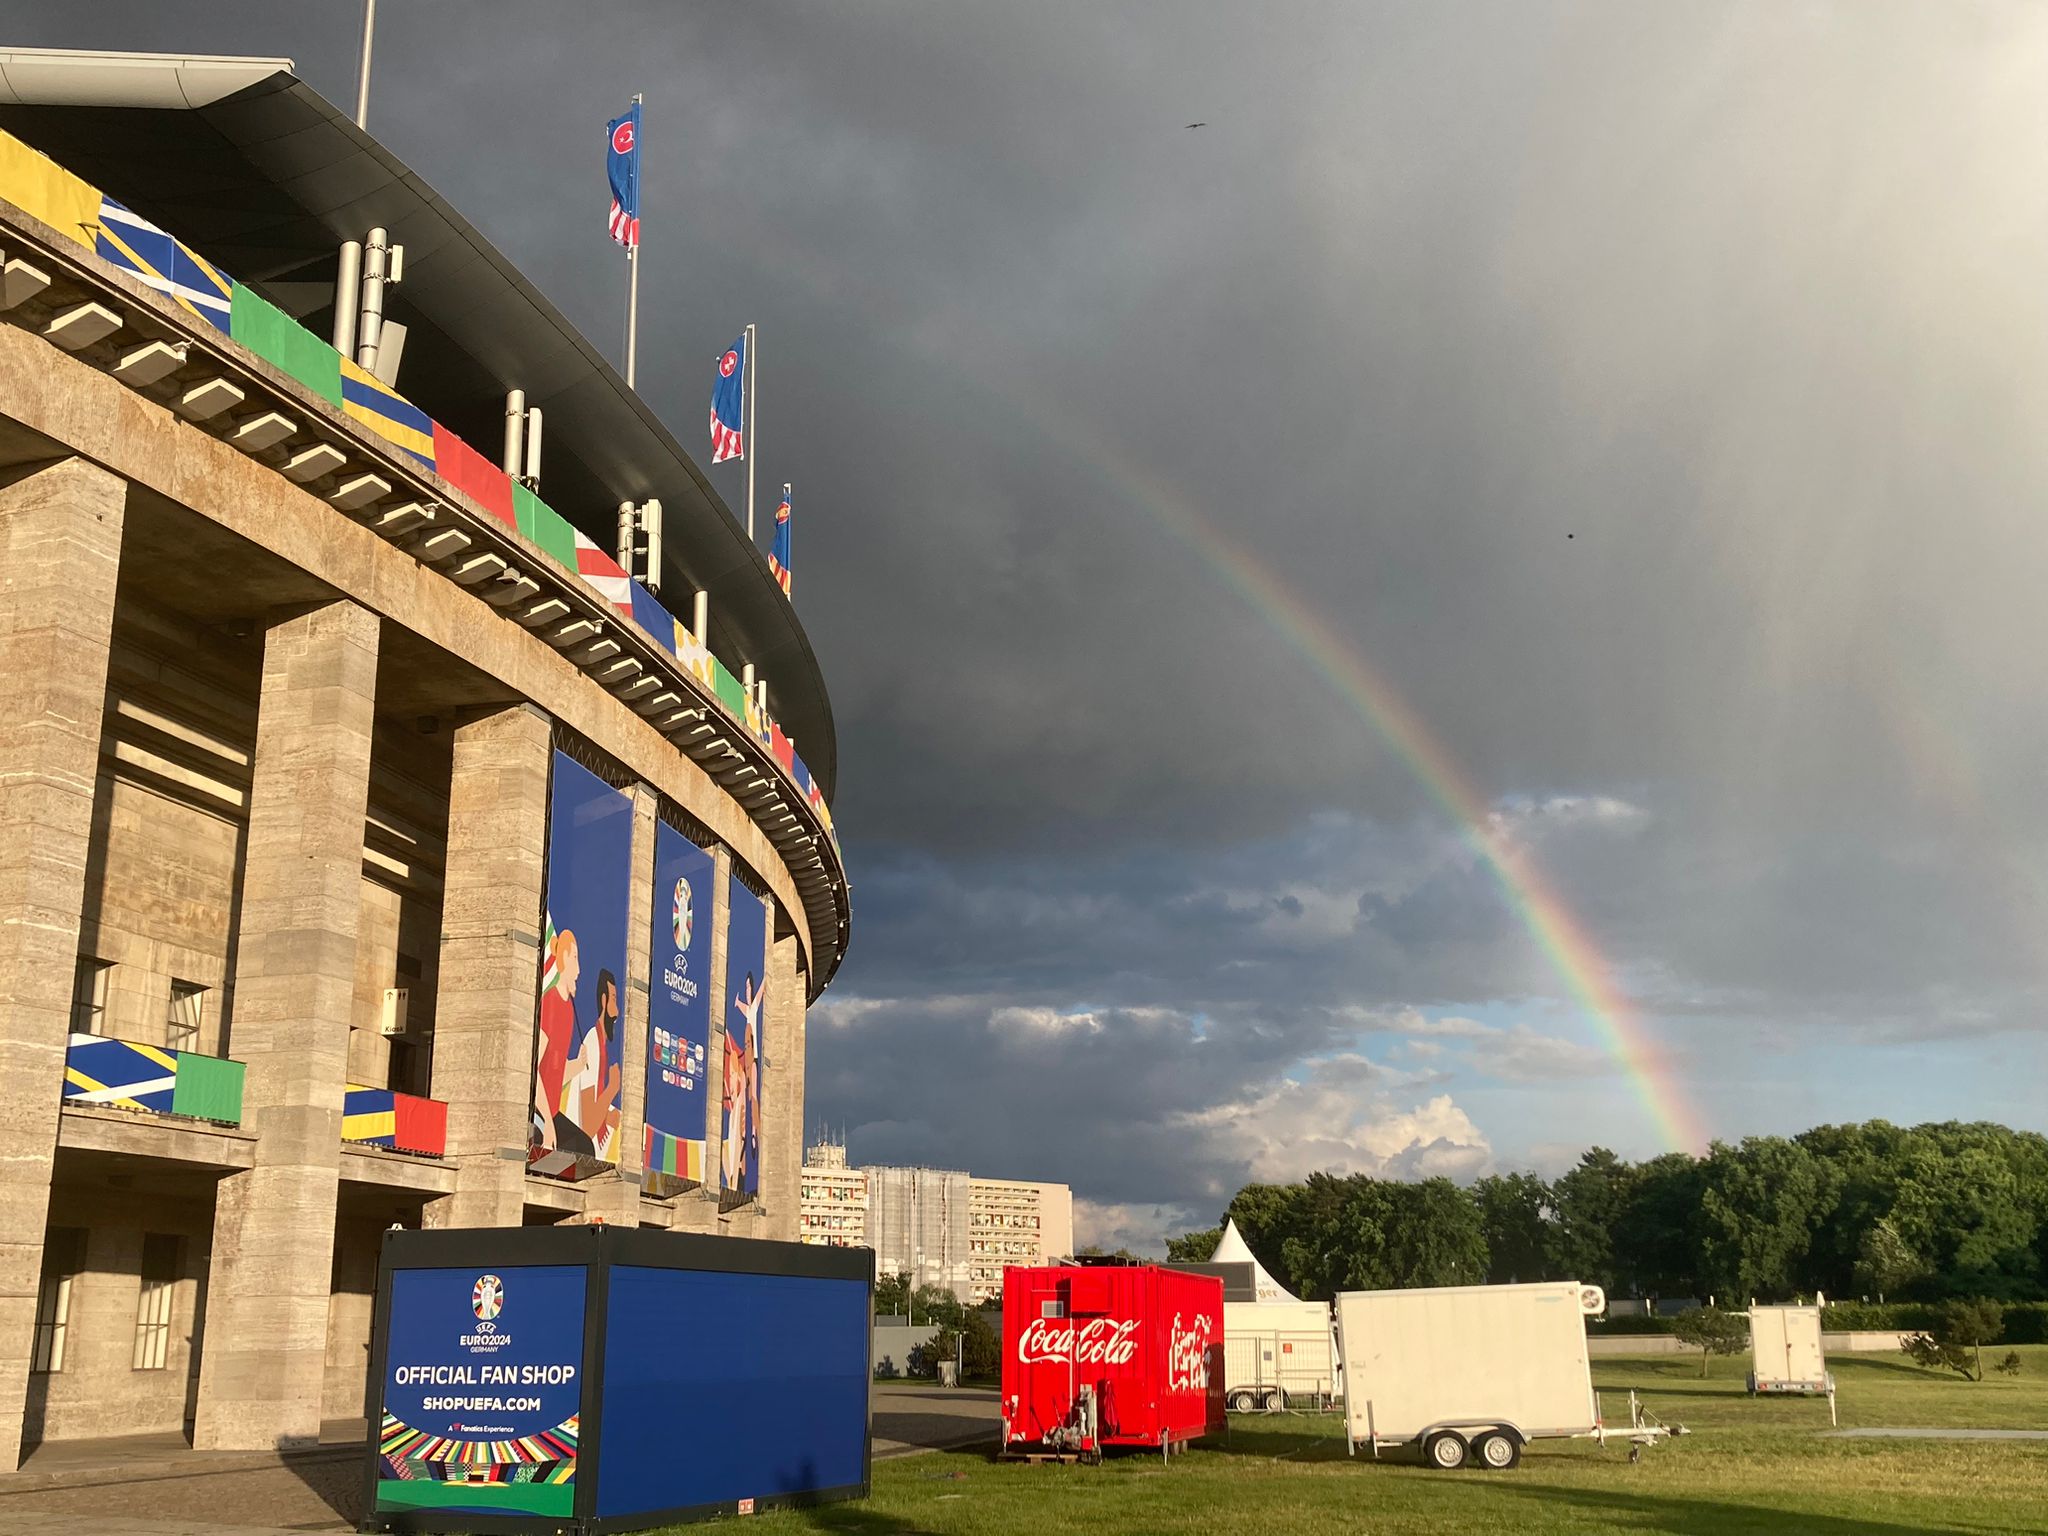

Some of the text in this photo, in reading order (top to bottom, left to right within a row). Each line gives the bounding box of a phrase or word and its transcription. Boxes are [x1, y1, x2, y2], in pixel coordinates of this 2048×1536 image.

[664, 968, 697, 998] EURO2024
[475, 1322, 496, 1334] UEFA
[460, 1335, 511, 1345] EURO2024
[395, 1365, 575, 1384] OFFICIAL FAN SHOP
[423, 1397, 541, 1411] SHOPUEFA.COM
[460, 1424, 483, 1432] Fanatics
[483, 1425, 514, 1433] Experience
